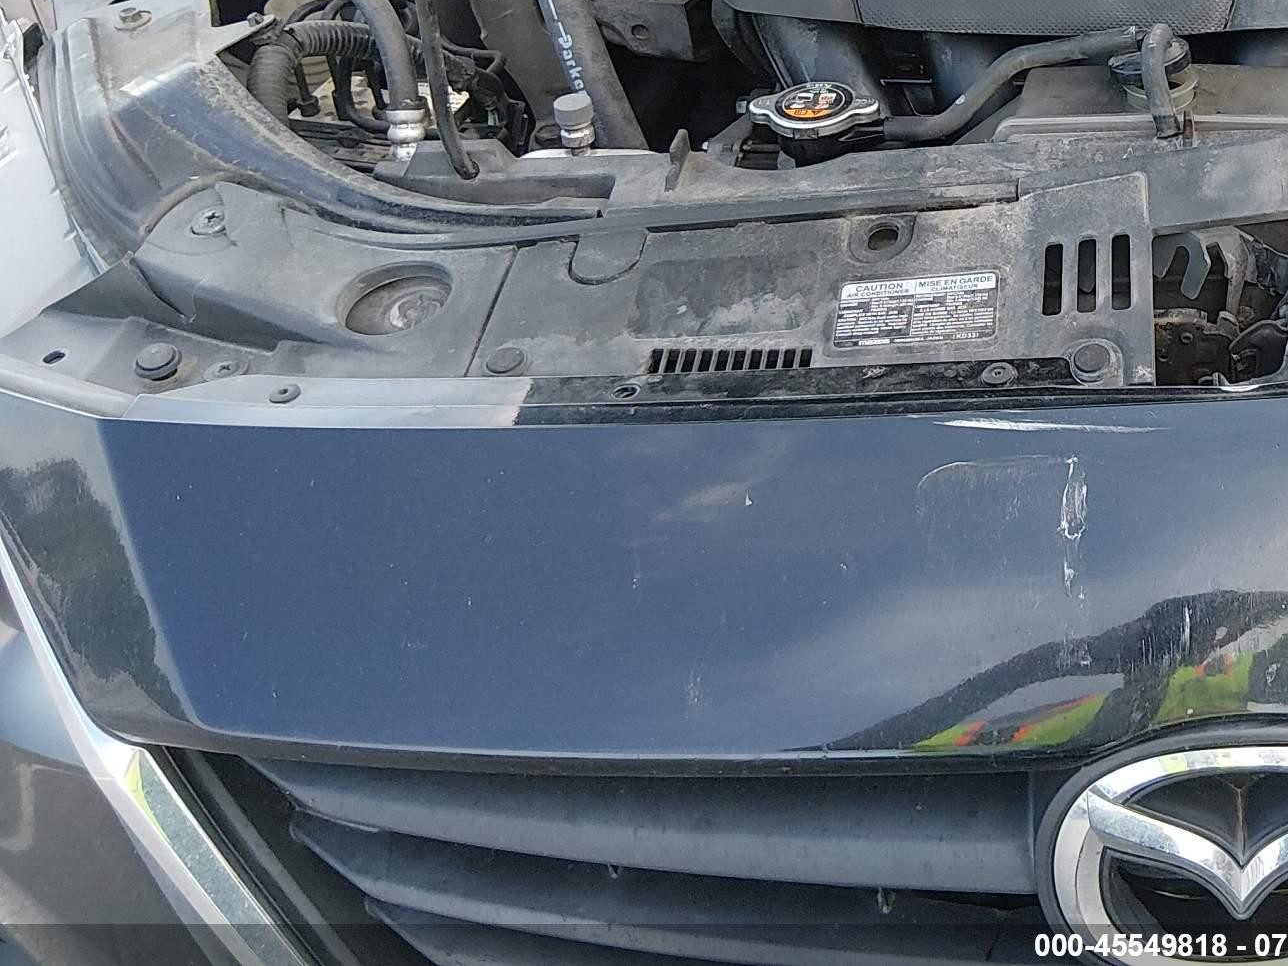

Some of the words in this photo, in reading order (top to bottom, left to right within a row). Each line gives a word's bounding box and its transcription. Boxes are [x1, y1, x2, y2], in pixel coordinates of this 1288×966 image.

[558, 34, 585, 92] Parke
[919, 280, 942, 288] MISE
[959, 275, 993, 284] GARDE
[855, 282, 904, 293] CAUTION
[858, 288, 909, 298] CONDITIONER
[931, 283, 978, 292] CLIMATISEUR
